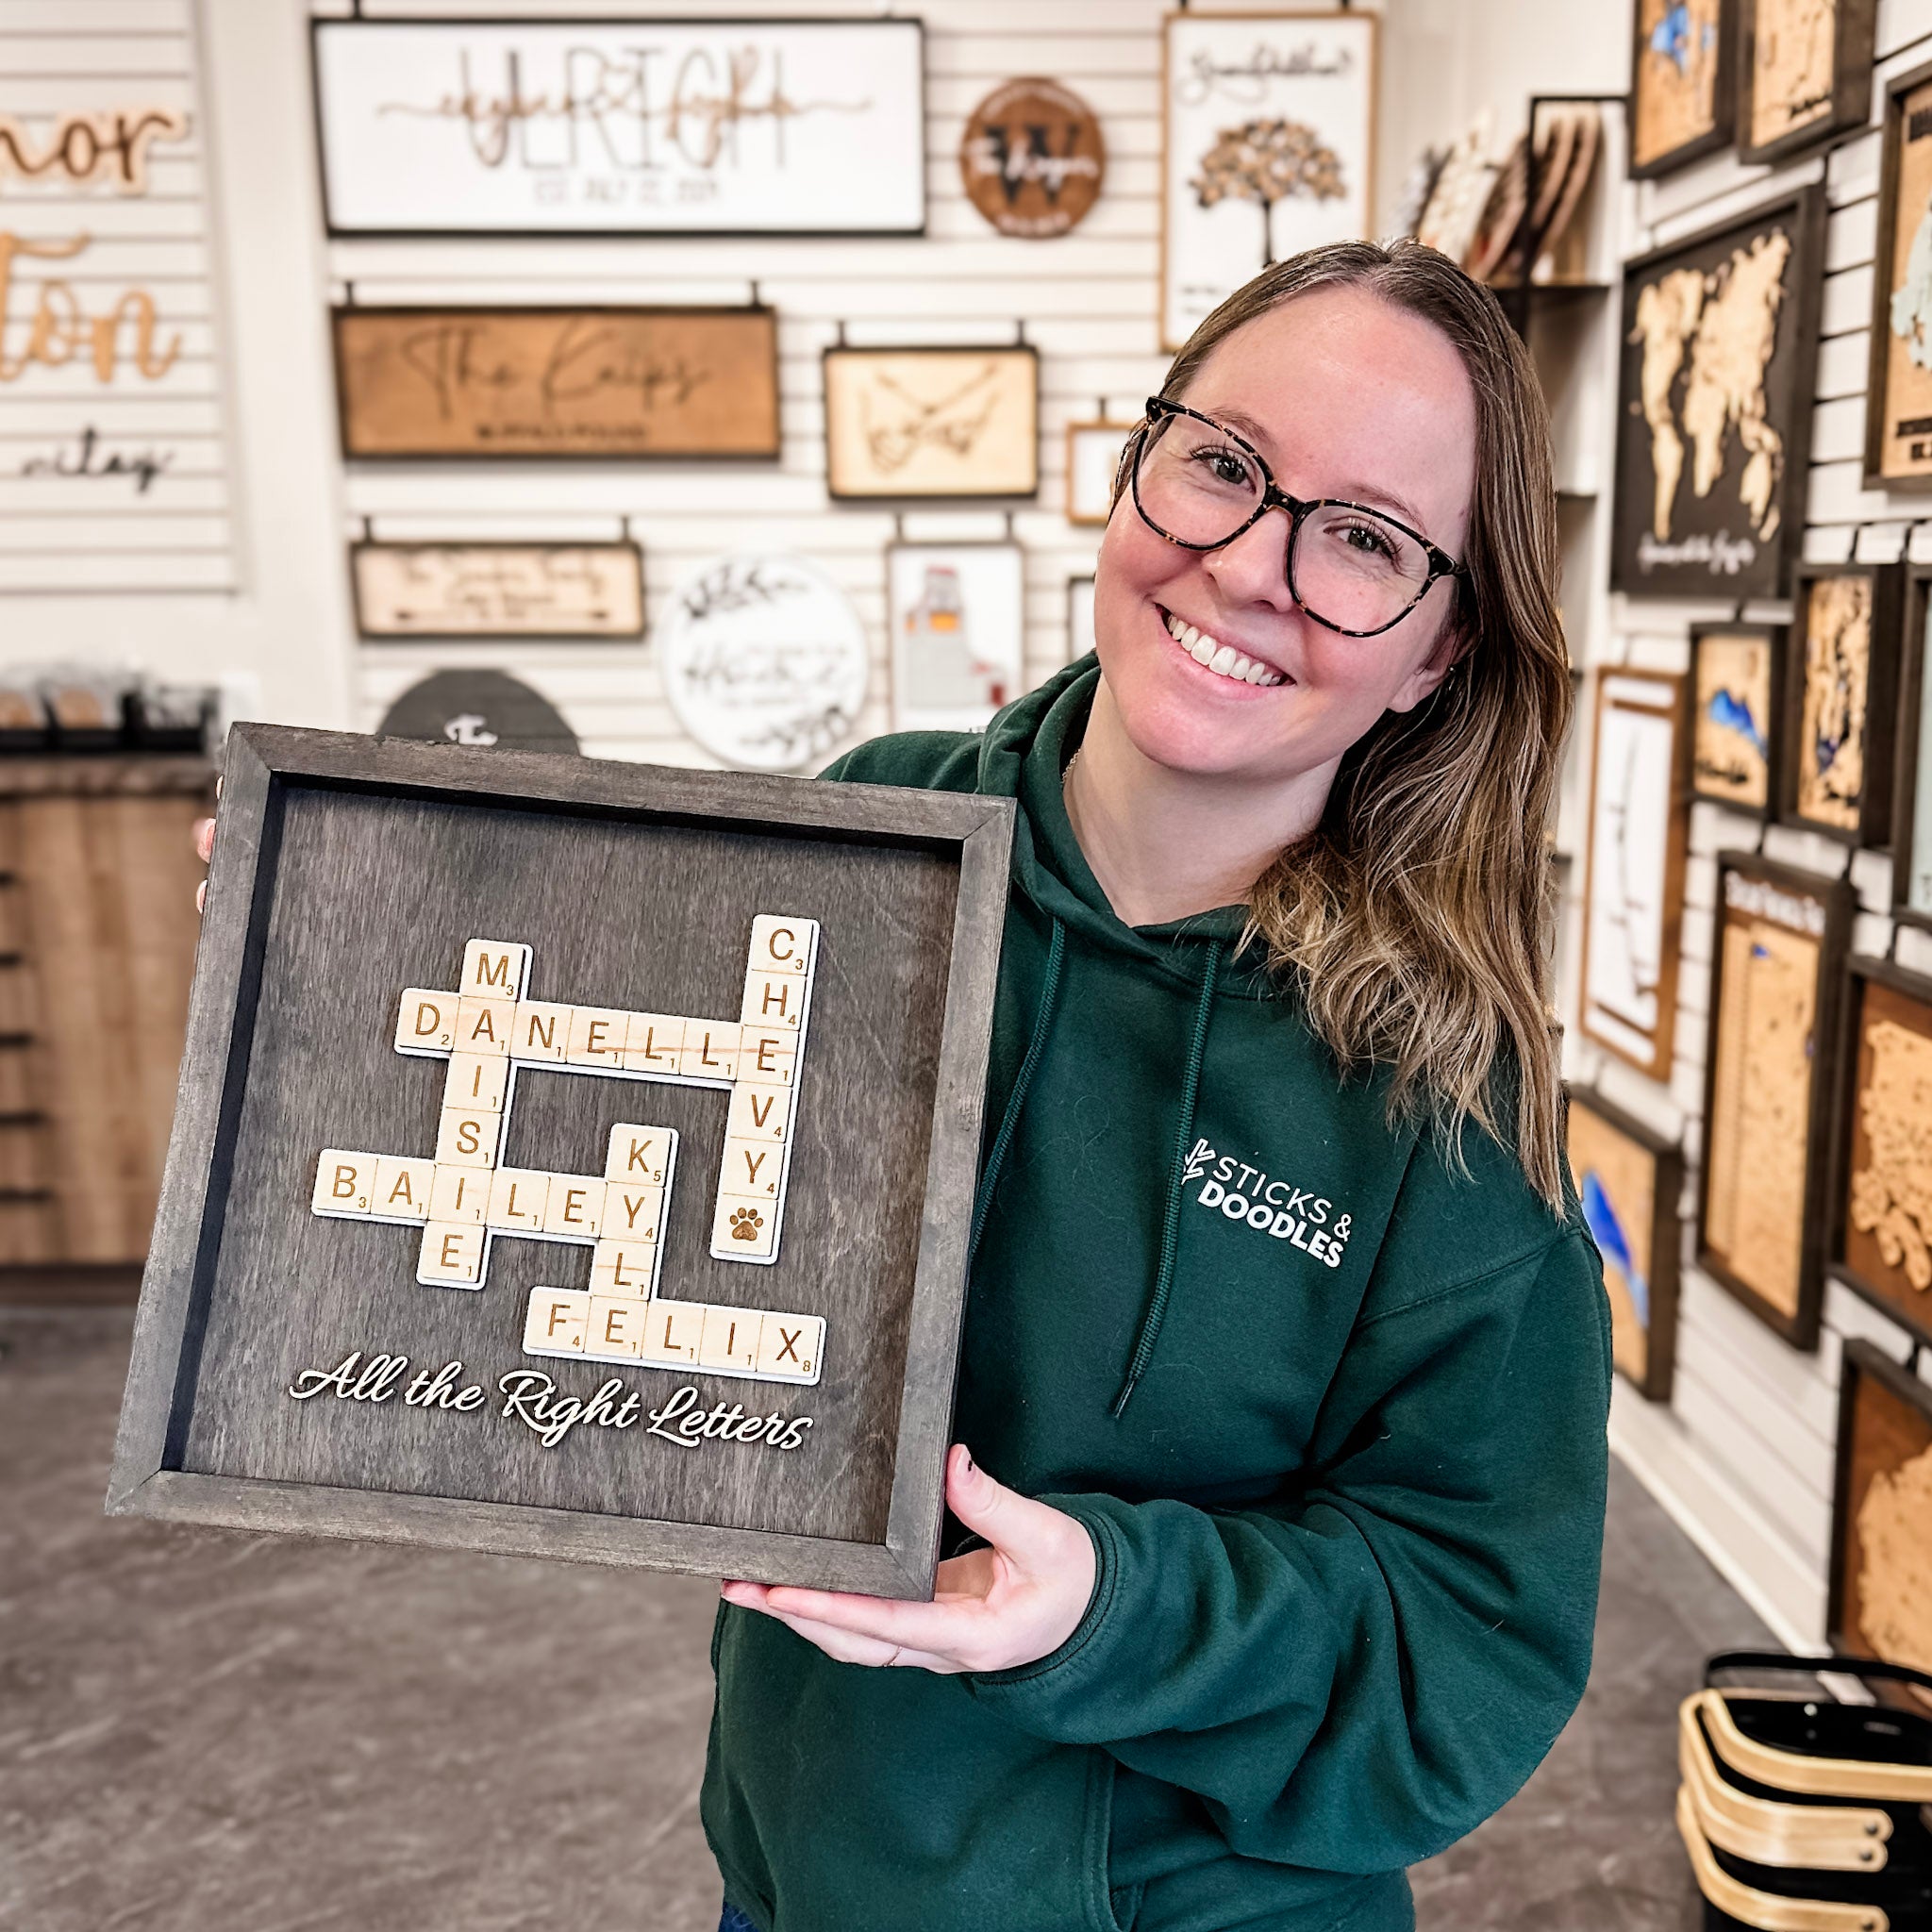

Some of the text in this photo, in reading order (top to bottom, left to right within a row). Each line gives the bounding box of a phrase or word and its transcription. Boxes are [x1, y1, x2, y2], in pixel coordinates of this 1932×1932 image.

[416, 1004, 779, 1072] DANELLE
[745, 929, 794, 1183] CHEVY
[441, 954, 508, 1267] MAISIE
[333, 1166, 644, 1228] BAILEY
[606, 1140, 652, 1343] KYLE
[1197, 1179, 1344, 1268] DOODLES
[1212, 1156, 1352, 1241] STICKS &
[548, 1304, 801, 1362] FELIX
[290, 1351, 813, 1451] All the Right Letters
